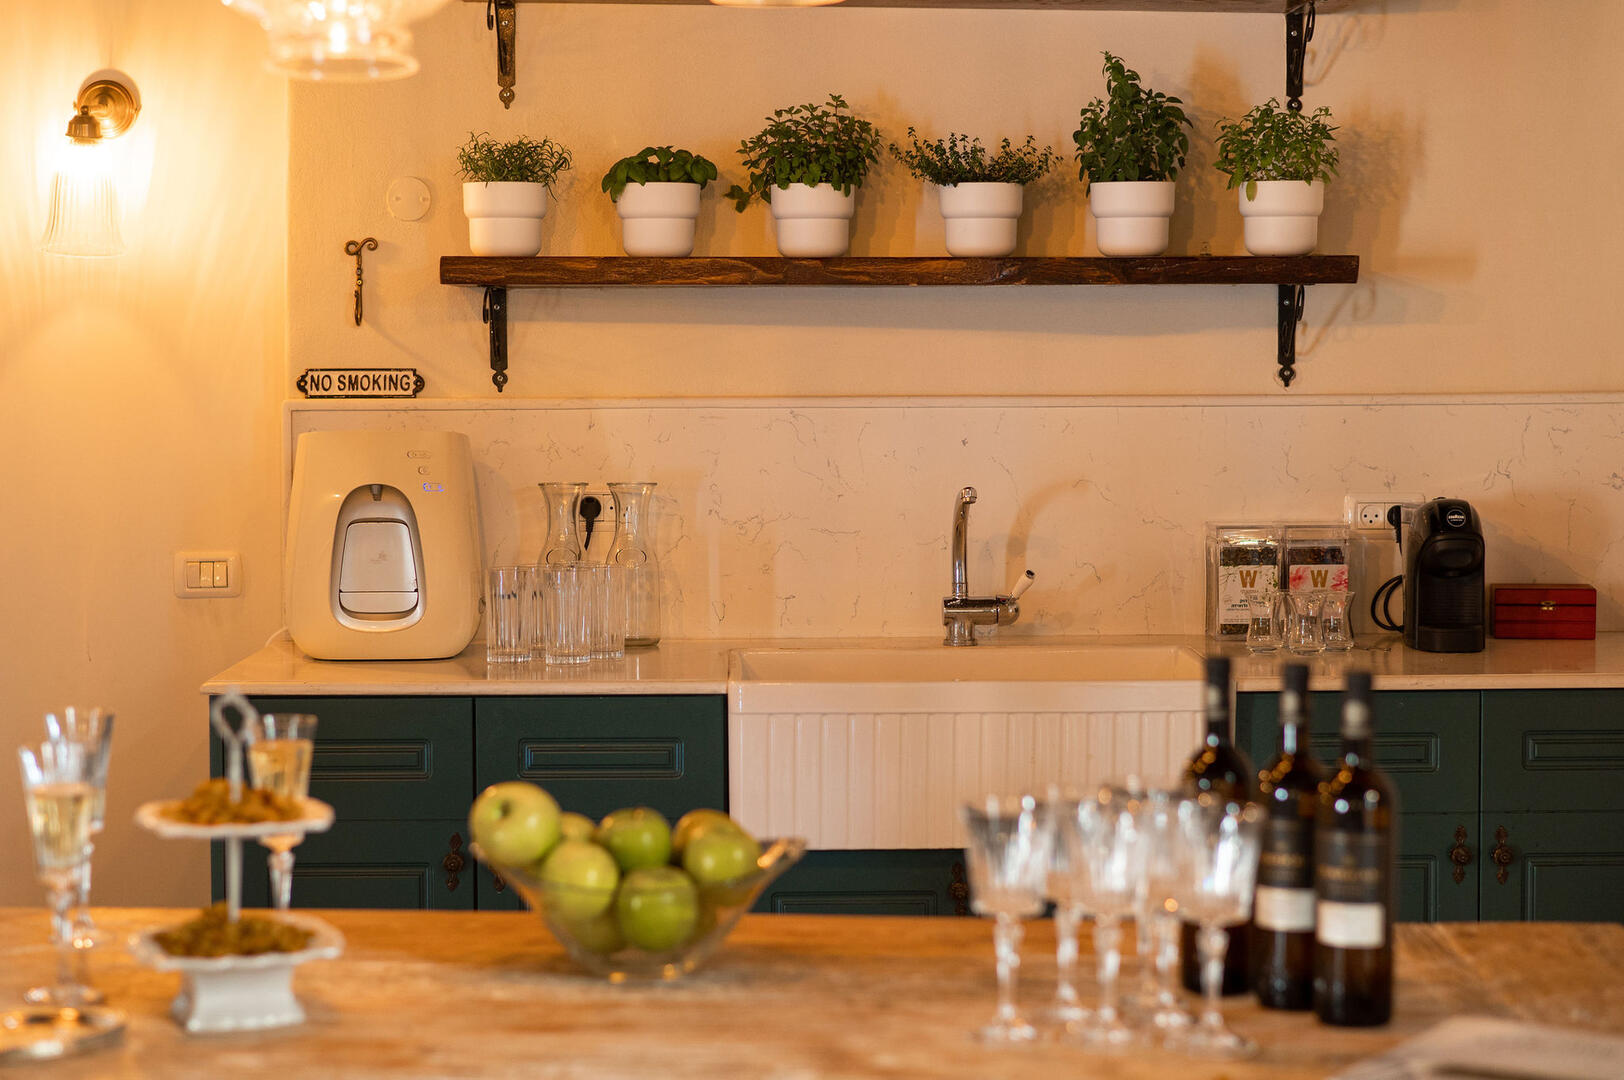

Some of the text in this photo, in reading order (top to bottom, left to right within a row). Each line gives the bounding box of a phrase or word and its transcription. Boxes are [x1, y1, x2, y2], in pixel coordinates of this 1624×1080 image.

[310, 374, 411, 392] NO SMOKING
[1239, 569, 1258, 588] W
[1310, 569, 1329, 588] W
